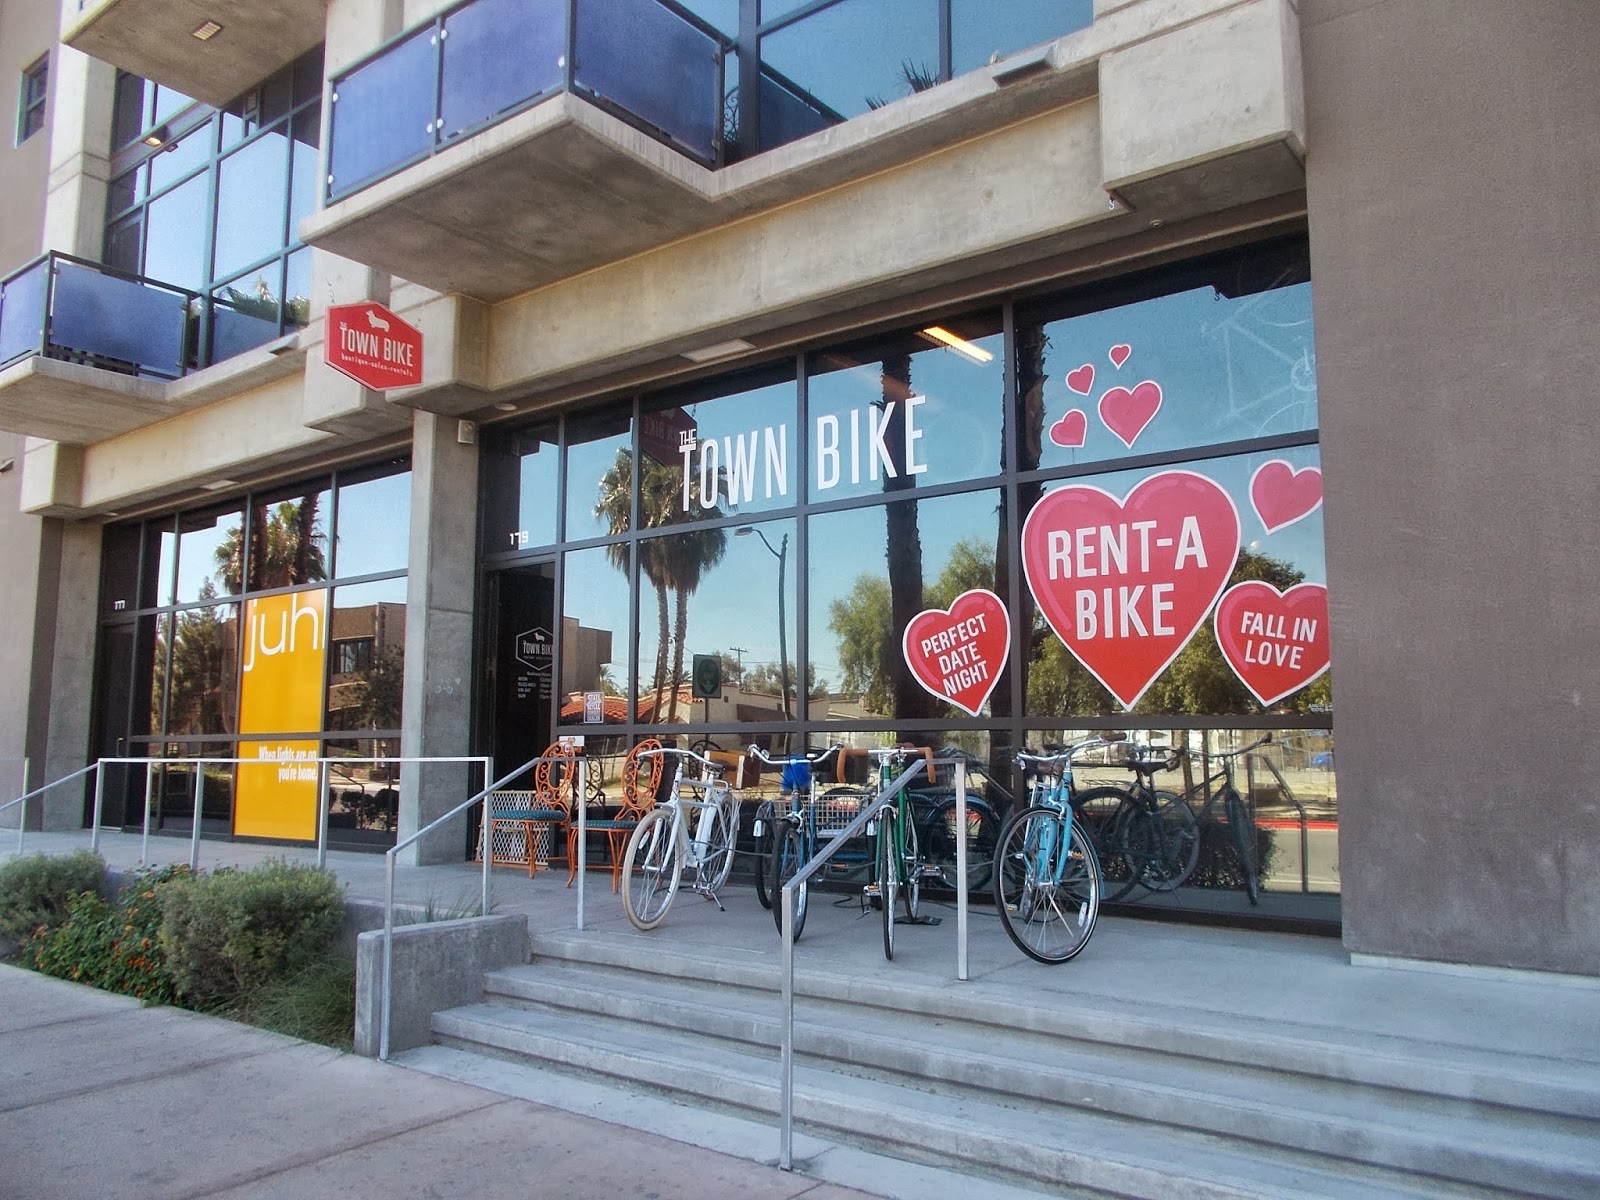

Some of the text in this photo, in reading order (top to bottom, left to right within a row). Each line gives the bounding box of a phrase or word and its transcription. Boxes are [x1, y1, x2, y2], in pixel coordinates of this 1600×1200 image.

[340, 327, 414, 367] TOWN BIKE
[679, 428, 697, 446] THE
[679, 395, 928, 512] TOWN BIKE
[1047, 516, 1208, 580] RENT-A
[1076, 583, 1175, 640] BIKE
[1240, 611, 1318, 643] FALL IN
[523, 642, 540, 655] TOWN
[921, 613, 988, 659] PERFECT
[937, 642, 981, 676] DATE
[1245, 641, 1305, 670] LOVE
[942, 661, 989, 698] NIGHT
